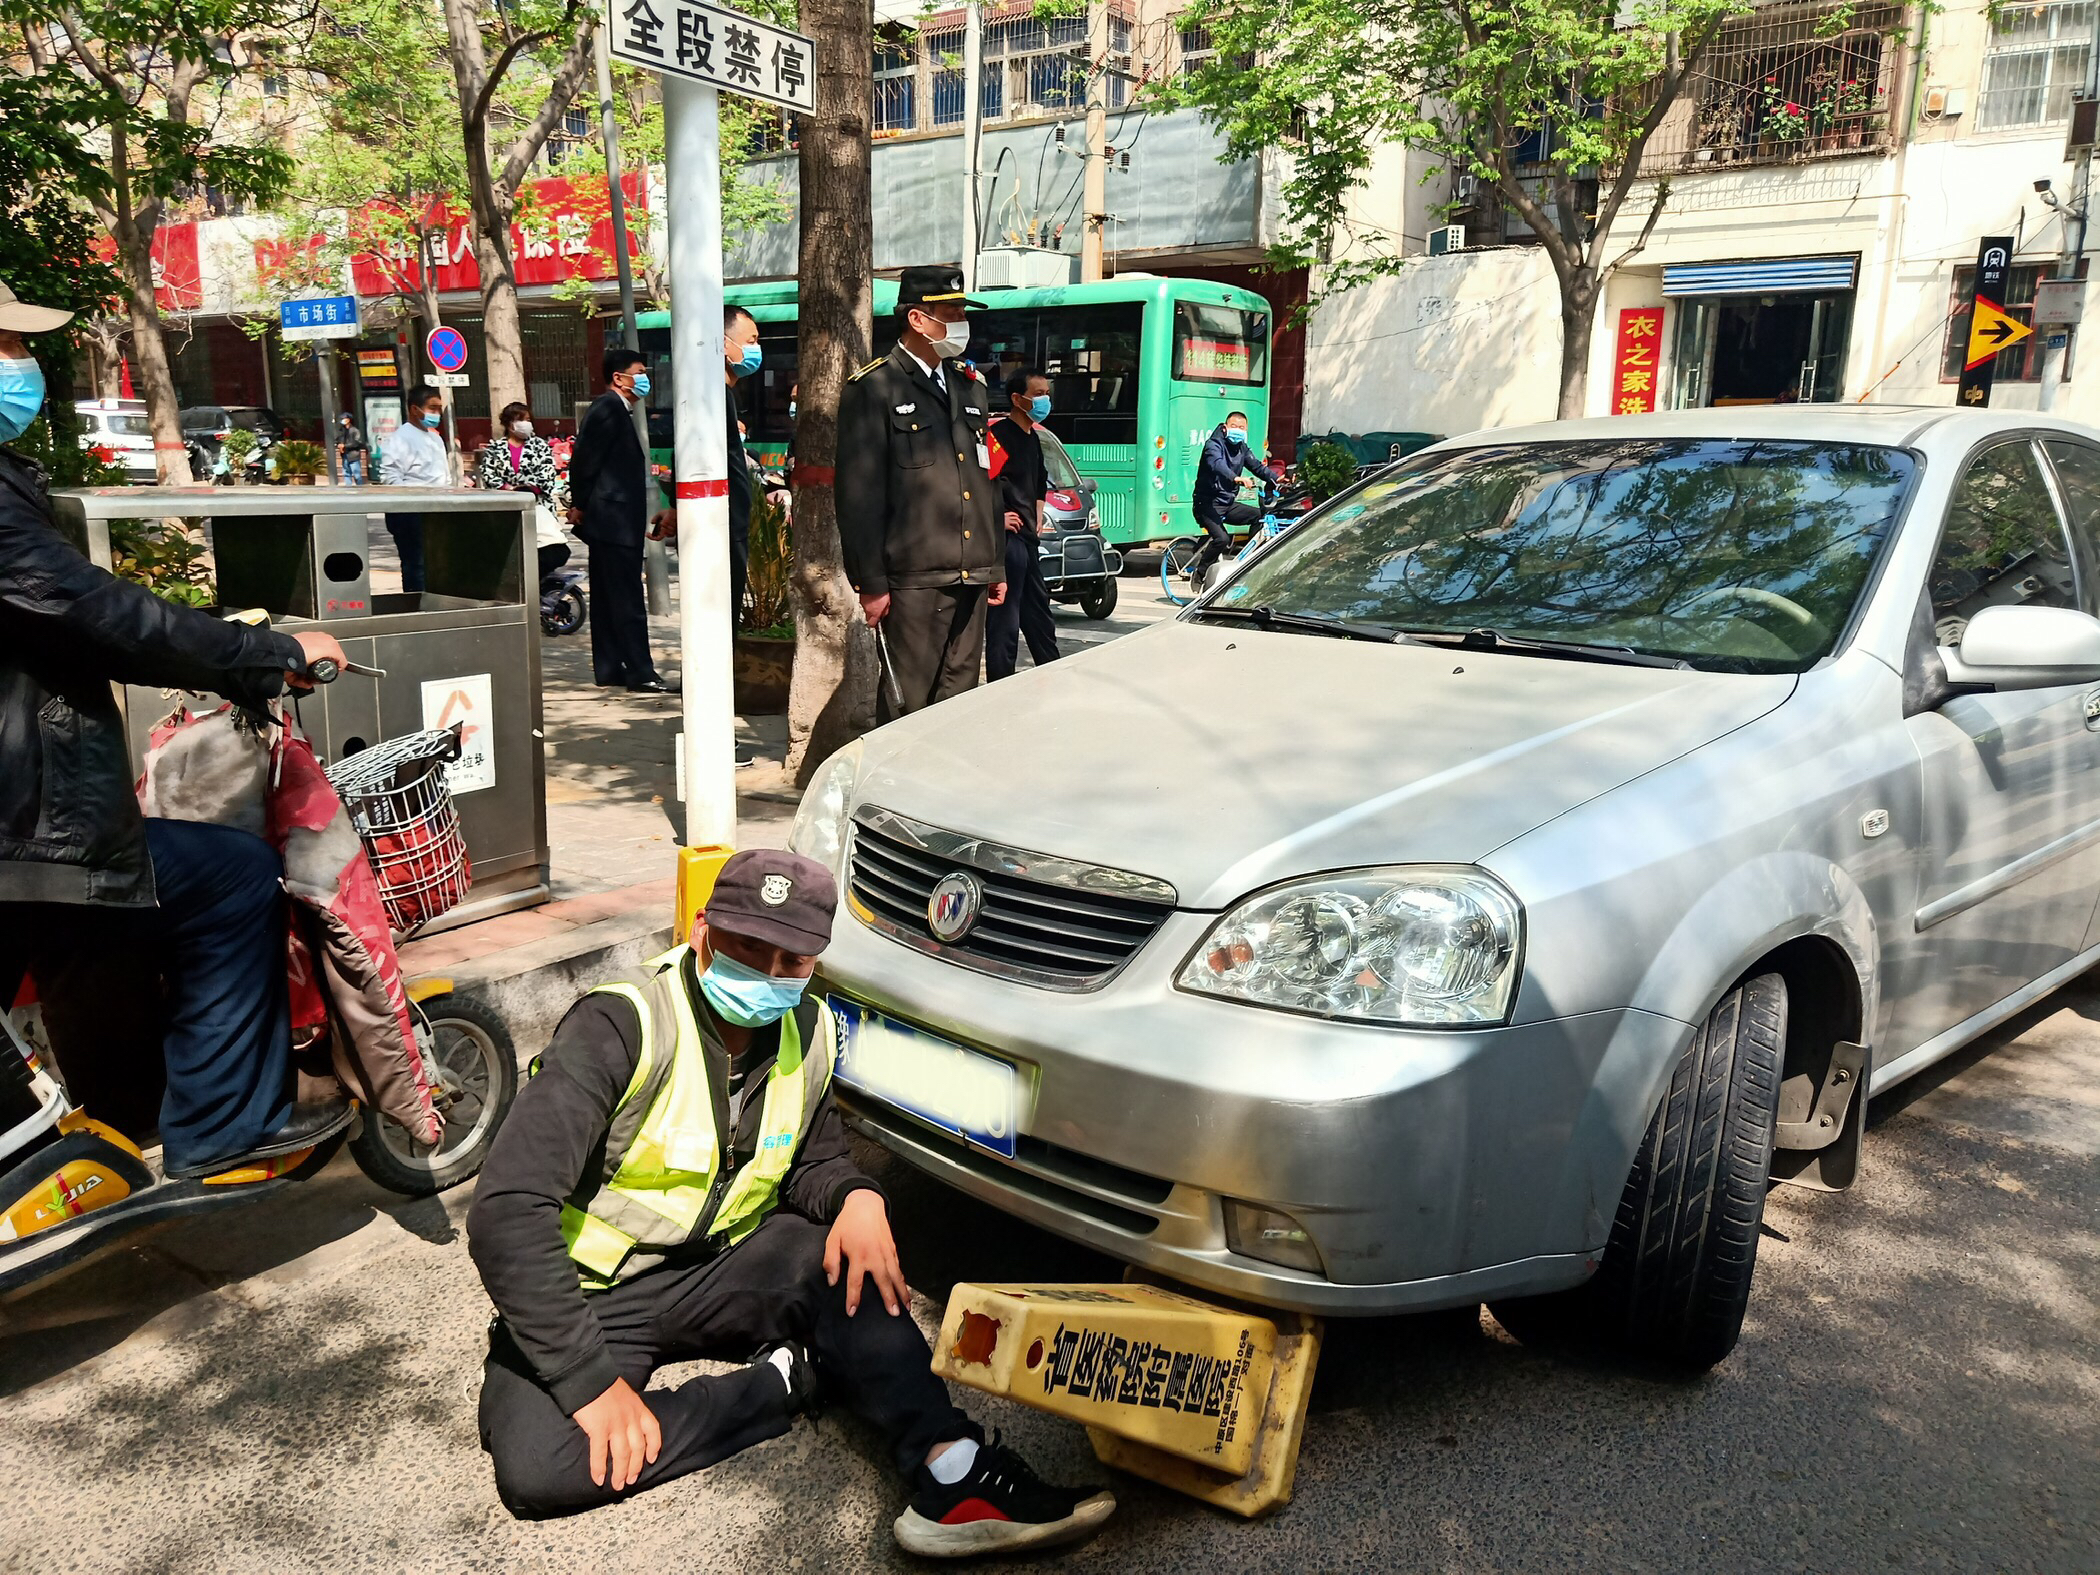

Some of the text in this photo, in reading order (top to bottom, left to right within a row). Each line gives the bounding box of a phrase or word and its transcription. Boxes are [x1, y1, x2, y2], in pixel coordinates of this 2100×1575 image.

[622, 0, 805, 98] 全段禁停
[298, 303, 337, 323] 市场街
[1043, 1321, 1233, 1418] 省医药院附属医院
[1214, 1328, 1250, 1456] 中原区建设西路106号
[1224, 1343, 1256, 1443] 国棉一厂对面
